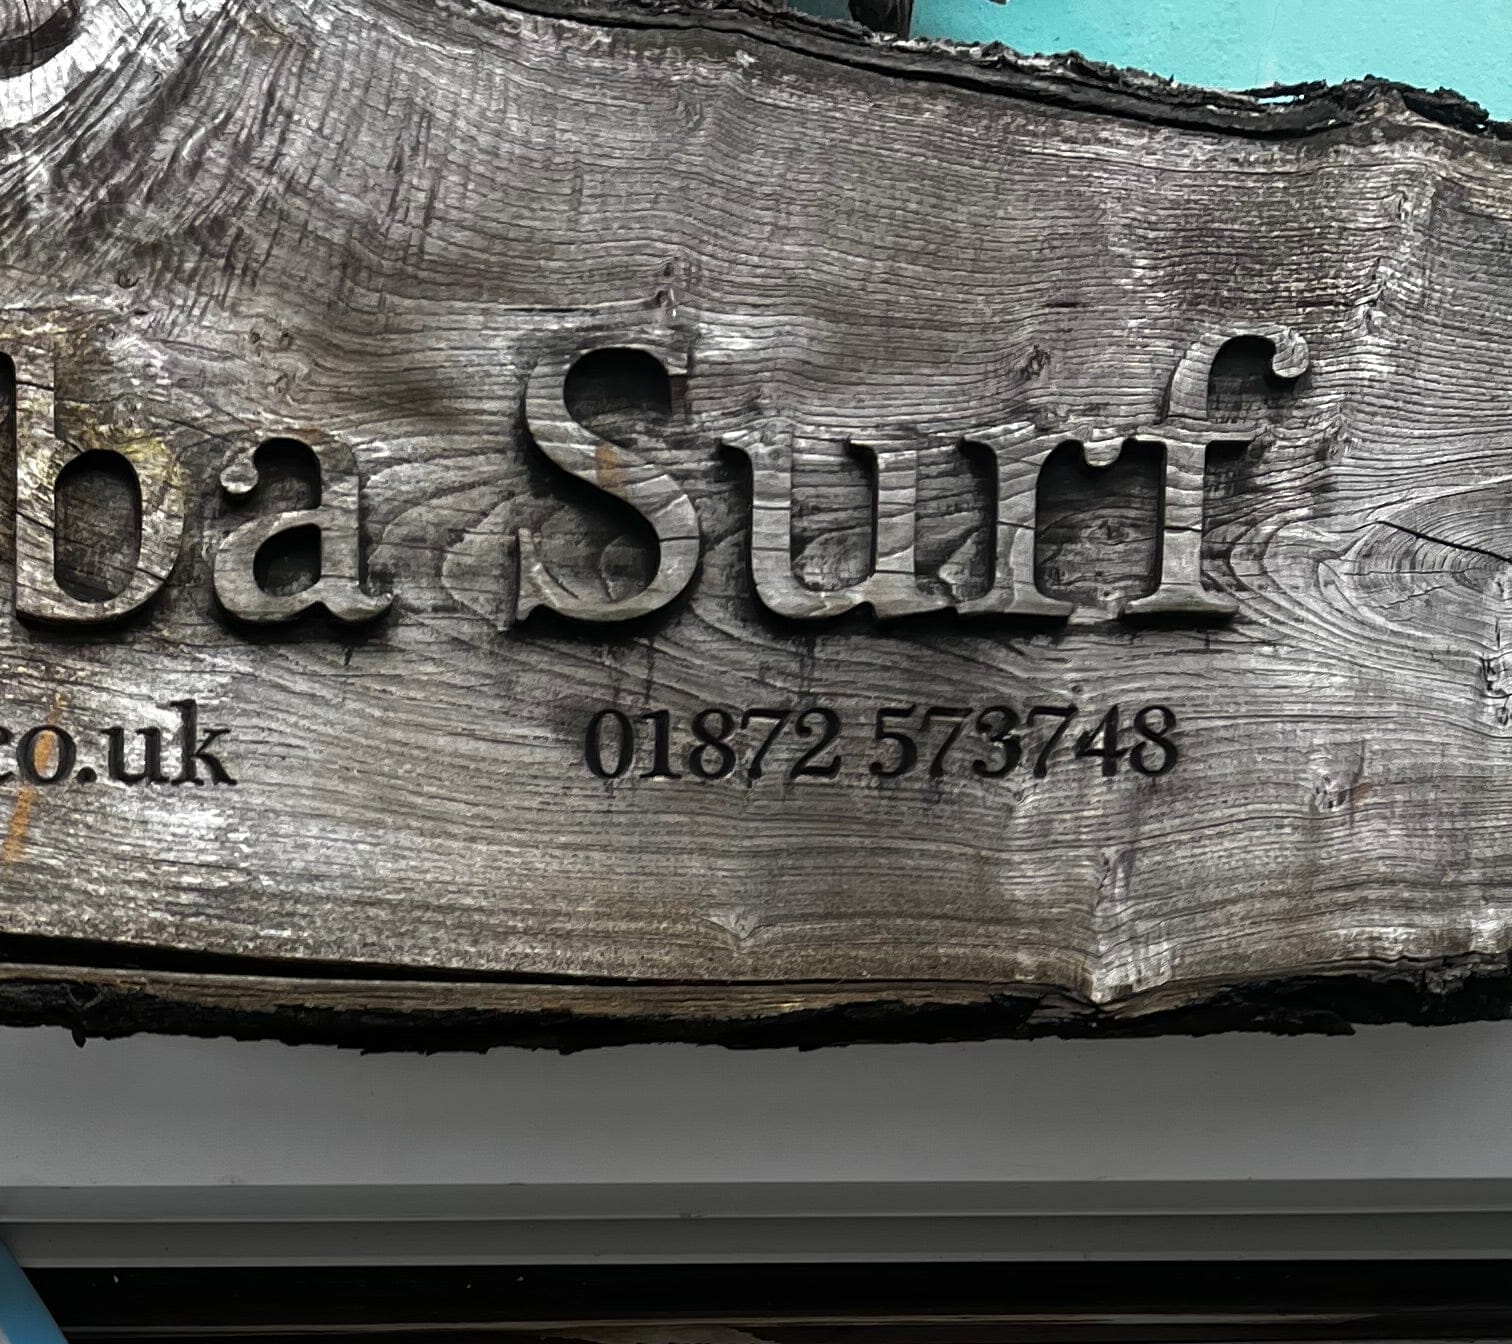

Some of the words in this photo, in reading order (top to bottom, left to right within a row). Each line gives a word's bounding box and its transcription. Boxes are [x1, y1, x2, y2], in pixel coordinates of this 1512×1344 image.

[502, 330, 1311, 625] Surf
[583, 706, 842, 781] 01872
[869, 703, 1180, 778] 573748
